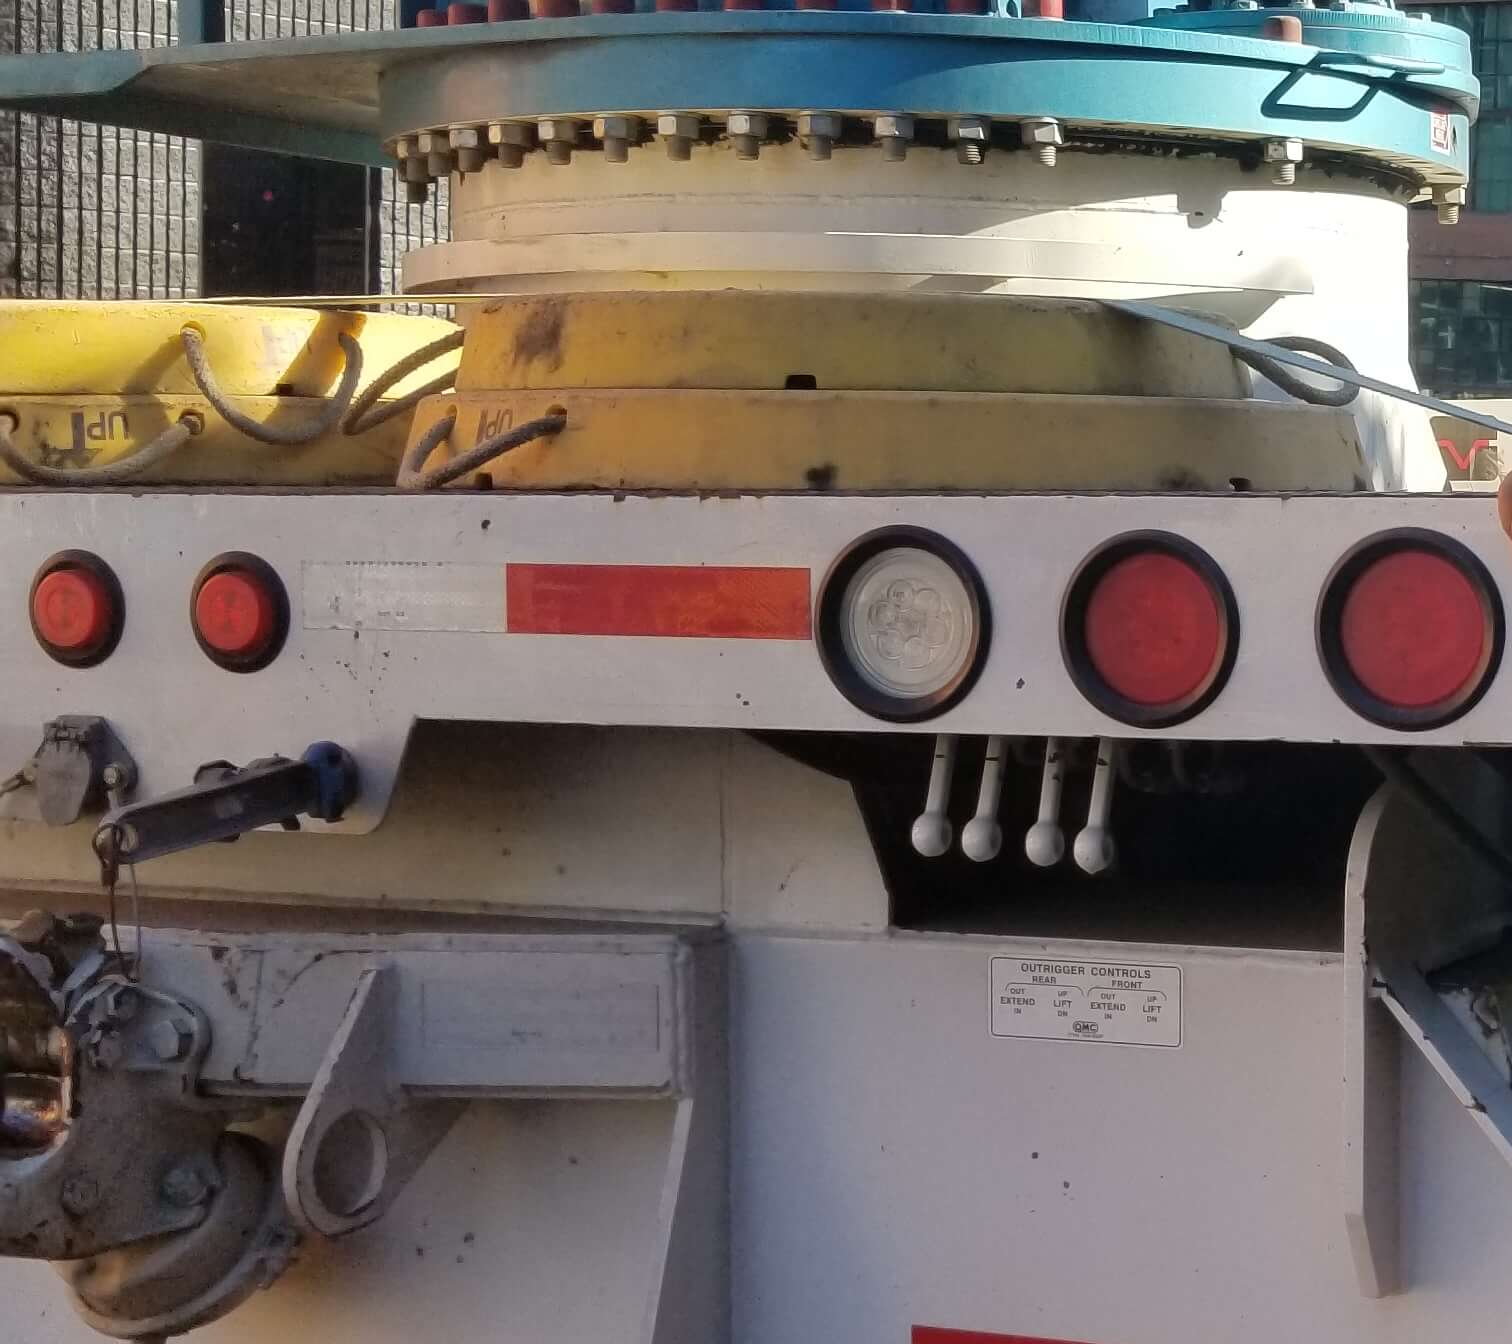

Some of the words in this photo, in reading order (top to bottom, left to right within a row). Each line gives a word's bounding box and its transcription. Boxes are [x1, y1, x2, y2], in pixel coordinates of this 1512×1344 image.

[1020, 962, 1085, 976] OUTRIGGER
[1090, 966, 1151, 979] CONTROLS
[1032, 975, 1057, 984] REAR
[1111, 979, 1143, 989] FRONT
[1010, 987, 1025, 995] OUT
[1100, 992, 1116, 1000] OUT
[1000, 996, 1036, 1006] EXTEND
[1053, 999, 1073, 1009] LIFT
[1013, 1007, 1022, 1015] IN
[1090, 1001, 1127, 1012] EXTEND
[1142, 1004, 1162, 1014] LIFT
[1146, 1015, 1158, 1023] DN
